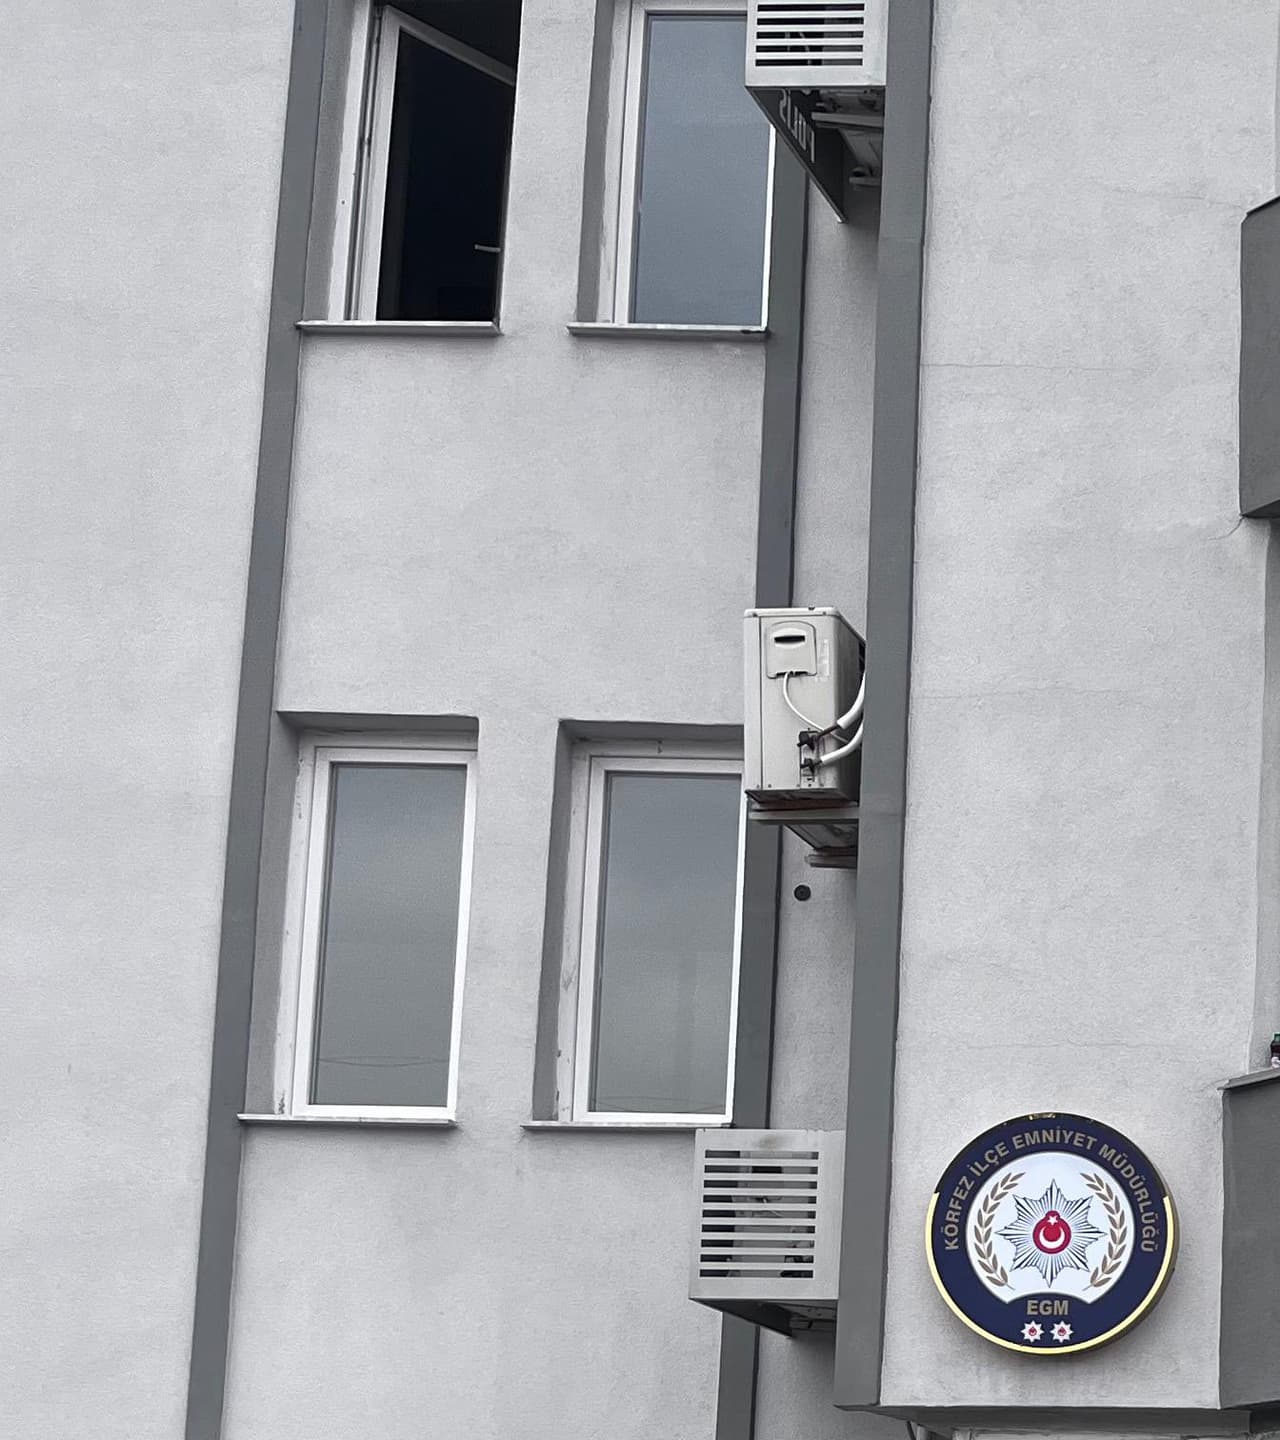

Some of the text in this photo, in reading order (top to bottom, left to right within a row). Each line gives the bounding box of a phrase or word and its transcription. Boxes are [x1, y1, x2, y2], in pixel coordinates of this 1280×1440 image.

[940, 1126, 1160, 1252] KÖRFEZ İLÇE EMNİYET MÜDÜRLÜĞÜ
[1026, 1299, 1069, 1316] EGM
